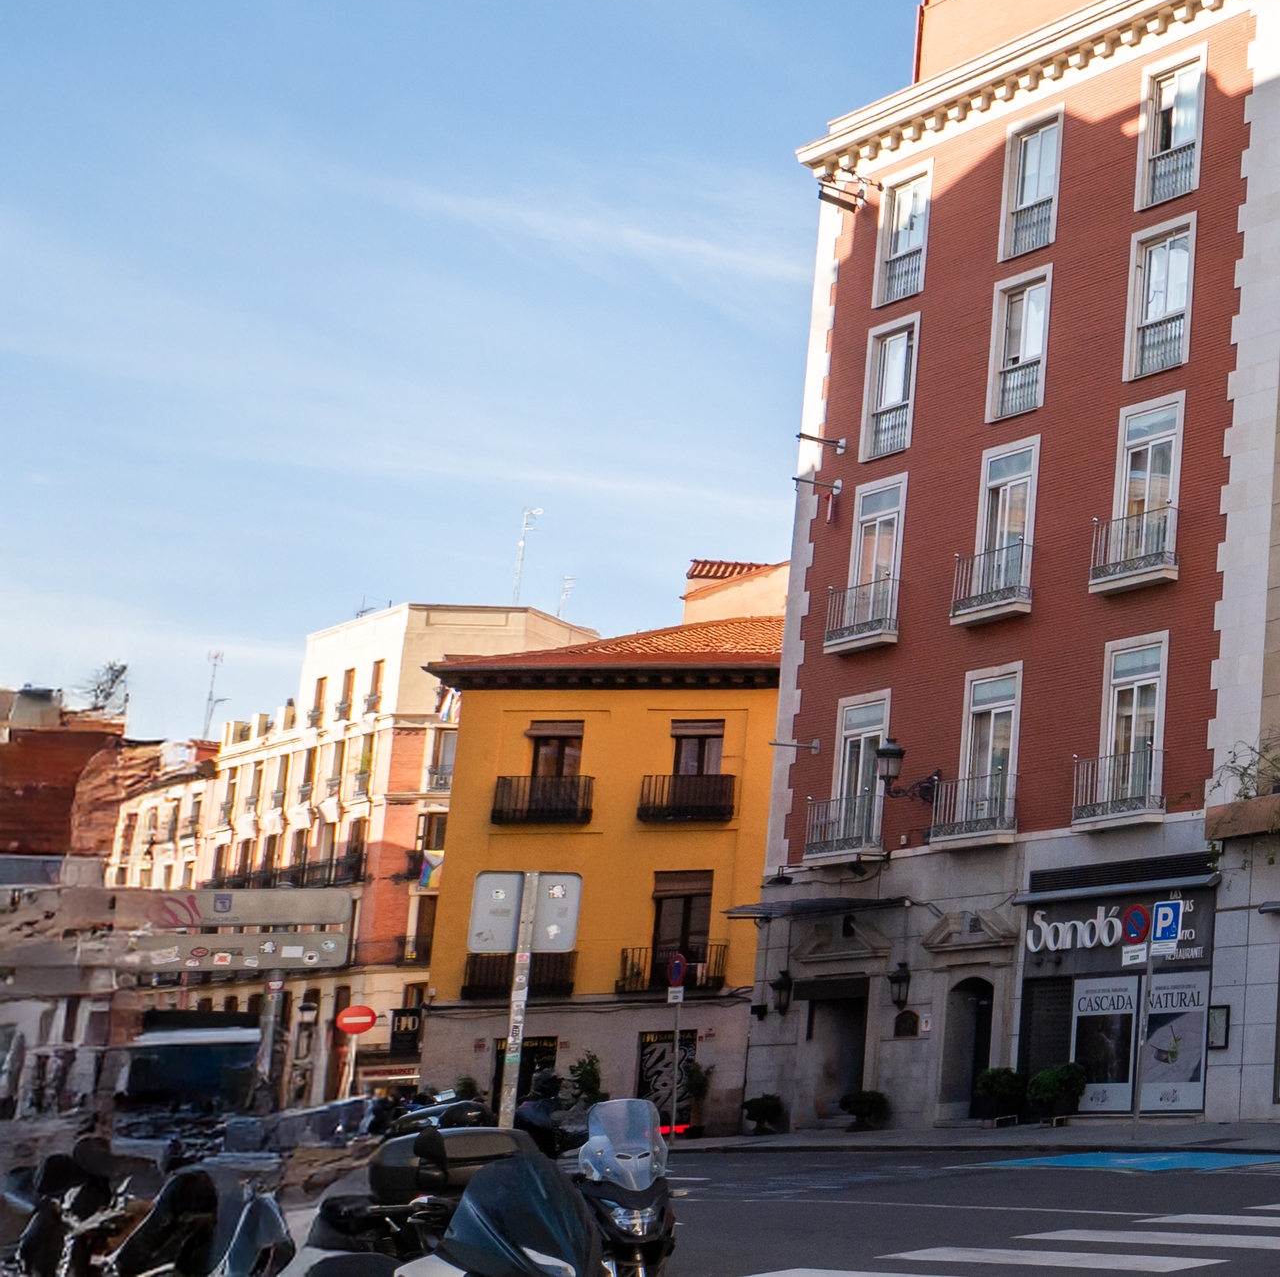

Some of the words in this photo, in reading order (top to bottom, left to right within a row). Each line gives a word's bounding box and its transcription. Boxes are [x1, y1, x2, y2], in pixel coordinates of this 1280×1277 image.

[1026, 905, 1123, 953] Sandó
[1156, 906, 1174, 938] P
[1078, 994, 1134, 1012] CASCADA
[1150, 990, 1204, 1009] NATURAL
